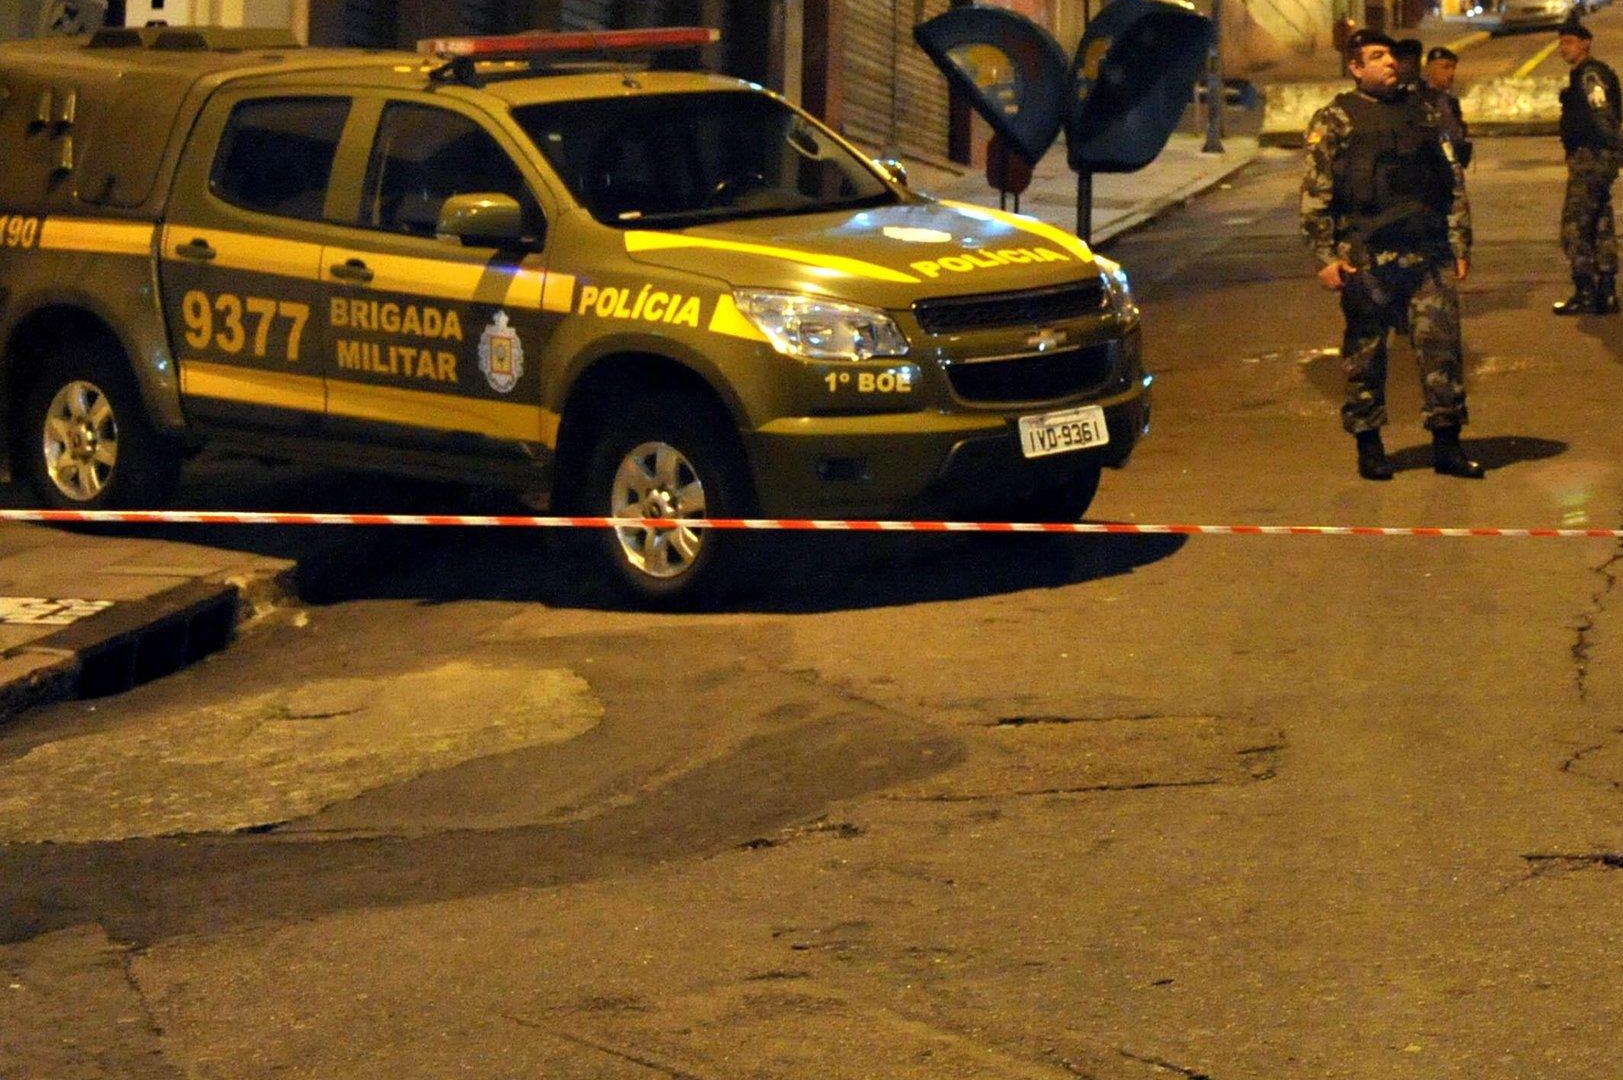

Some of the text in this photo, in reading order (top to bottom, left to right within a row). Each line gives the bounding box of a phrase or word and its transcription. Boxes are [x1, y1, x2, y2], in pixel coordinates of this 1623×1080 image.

[182, 290, 310, 361] 9377
[330, 297, 463, 341] BRIGADA
[578, 283, 701, 328] POLÍCIA
[337, 339, 458, 383] MILITAR
[858, 373, 912, 392] BOE
